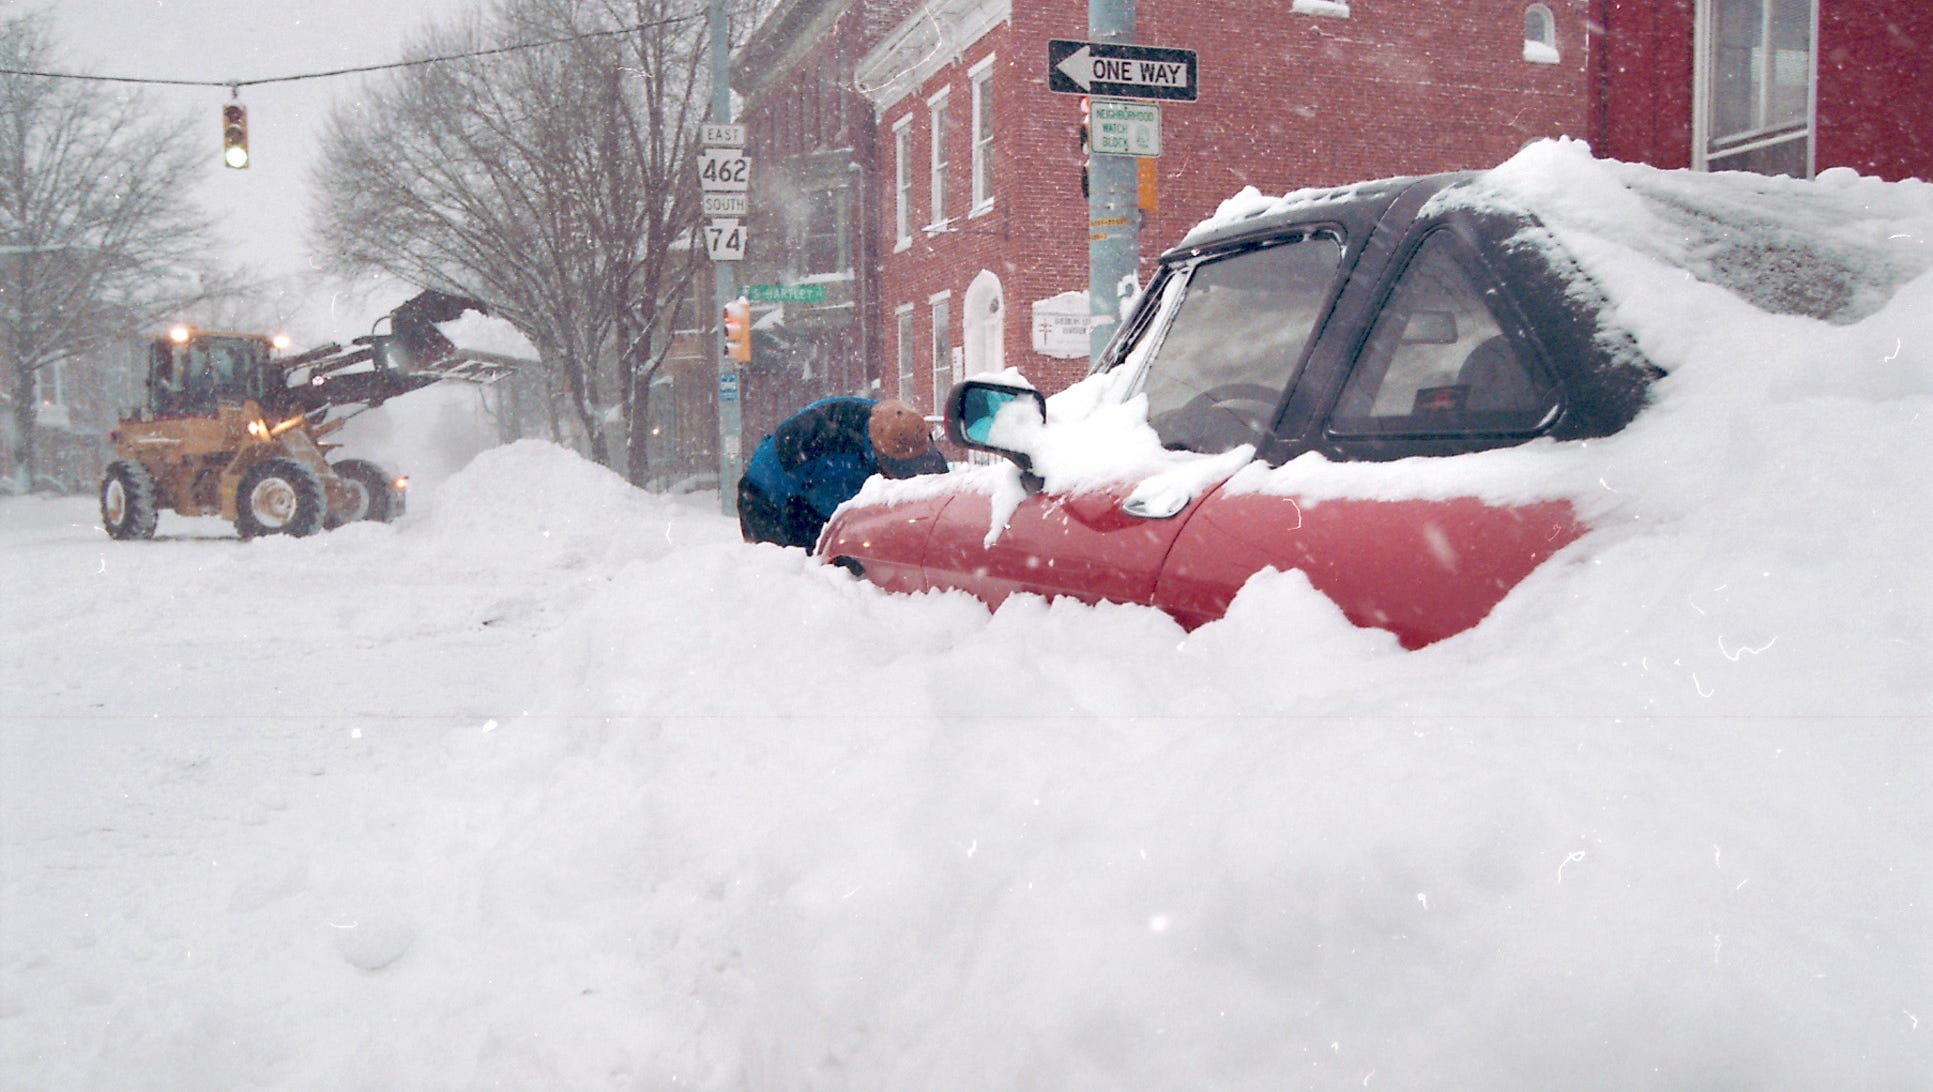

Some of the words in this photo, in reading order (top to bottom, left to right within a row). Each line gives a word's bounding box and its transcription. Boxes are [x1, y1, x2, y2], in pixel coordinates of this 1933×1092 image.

[1093, 59, 1133, 82] ONE
[1139, 62, 1181, 85] WAY
[1096, 108, 1154, 122] NEIGHBORHOOD
[707, 128, 739, 141] EAST
[1102, 123, 1128, 135] WATCH
[702, 158, 747, 182] 462
[705, 198, 745, 211] SOUTH
[710, 228, 740, 252] 74
[766, 287, 814, 300] HARTLEY
